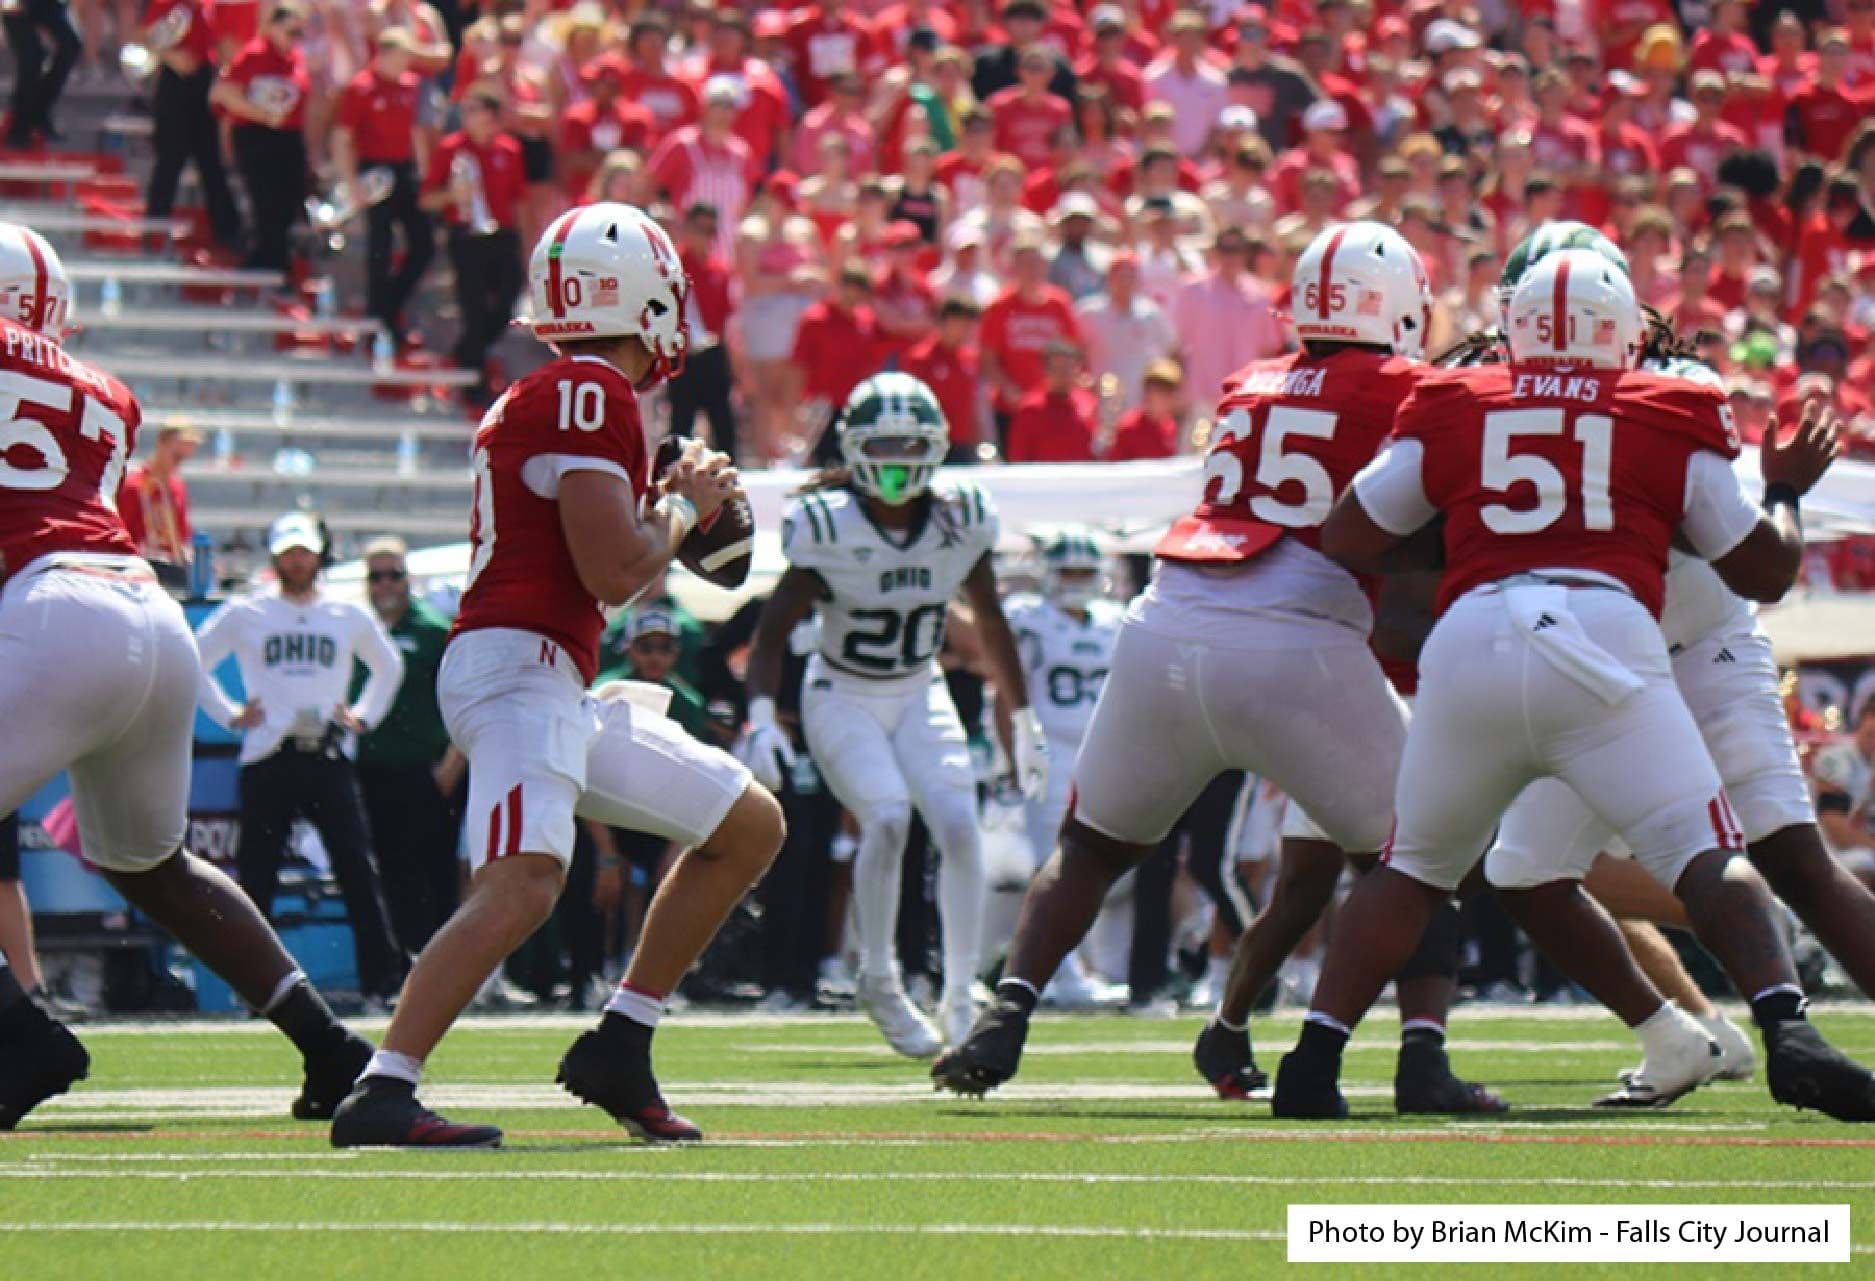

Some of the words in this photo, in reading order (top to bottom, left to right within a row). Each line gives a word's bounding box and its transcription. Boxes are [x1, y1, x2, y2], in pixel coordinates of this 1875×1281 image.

[18, 293, 58, 323] 57
[1304, 282, 1347, 312] 65
[1535, 314, 1577, 345] 51
[1513, 373, 1601, 403] EVANS
[556, 379, 606, 432] 10
[0, 370, 128, 514] 57
[1202, 404, 1335, 529] 65
[1478, 407, 1616, 535] 51
[879, 566, 932, 595] OHIO
[264, 633, 336, 667] OHIO
[842, 602, 946, 671] 20
[539, 638, 557, 668] N
